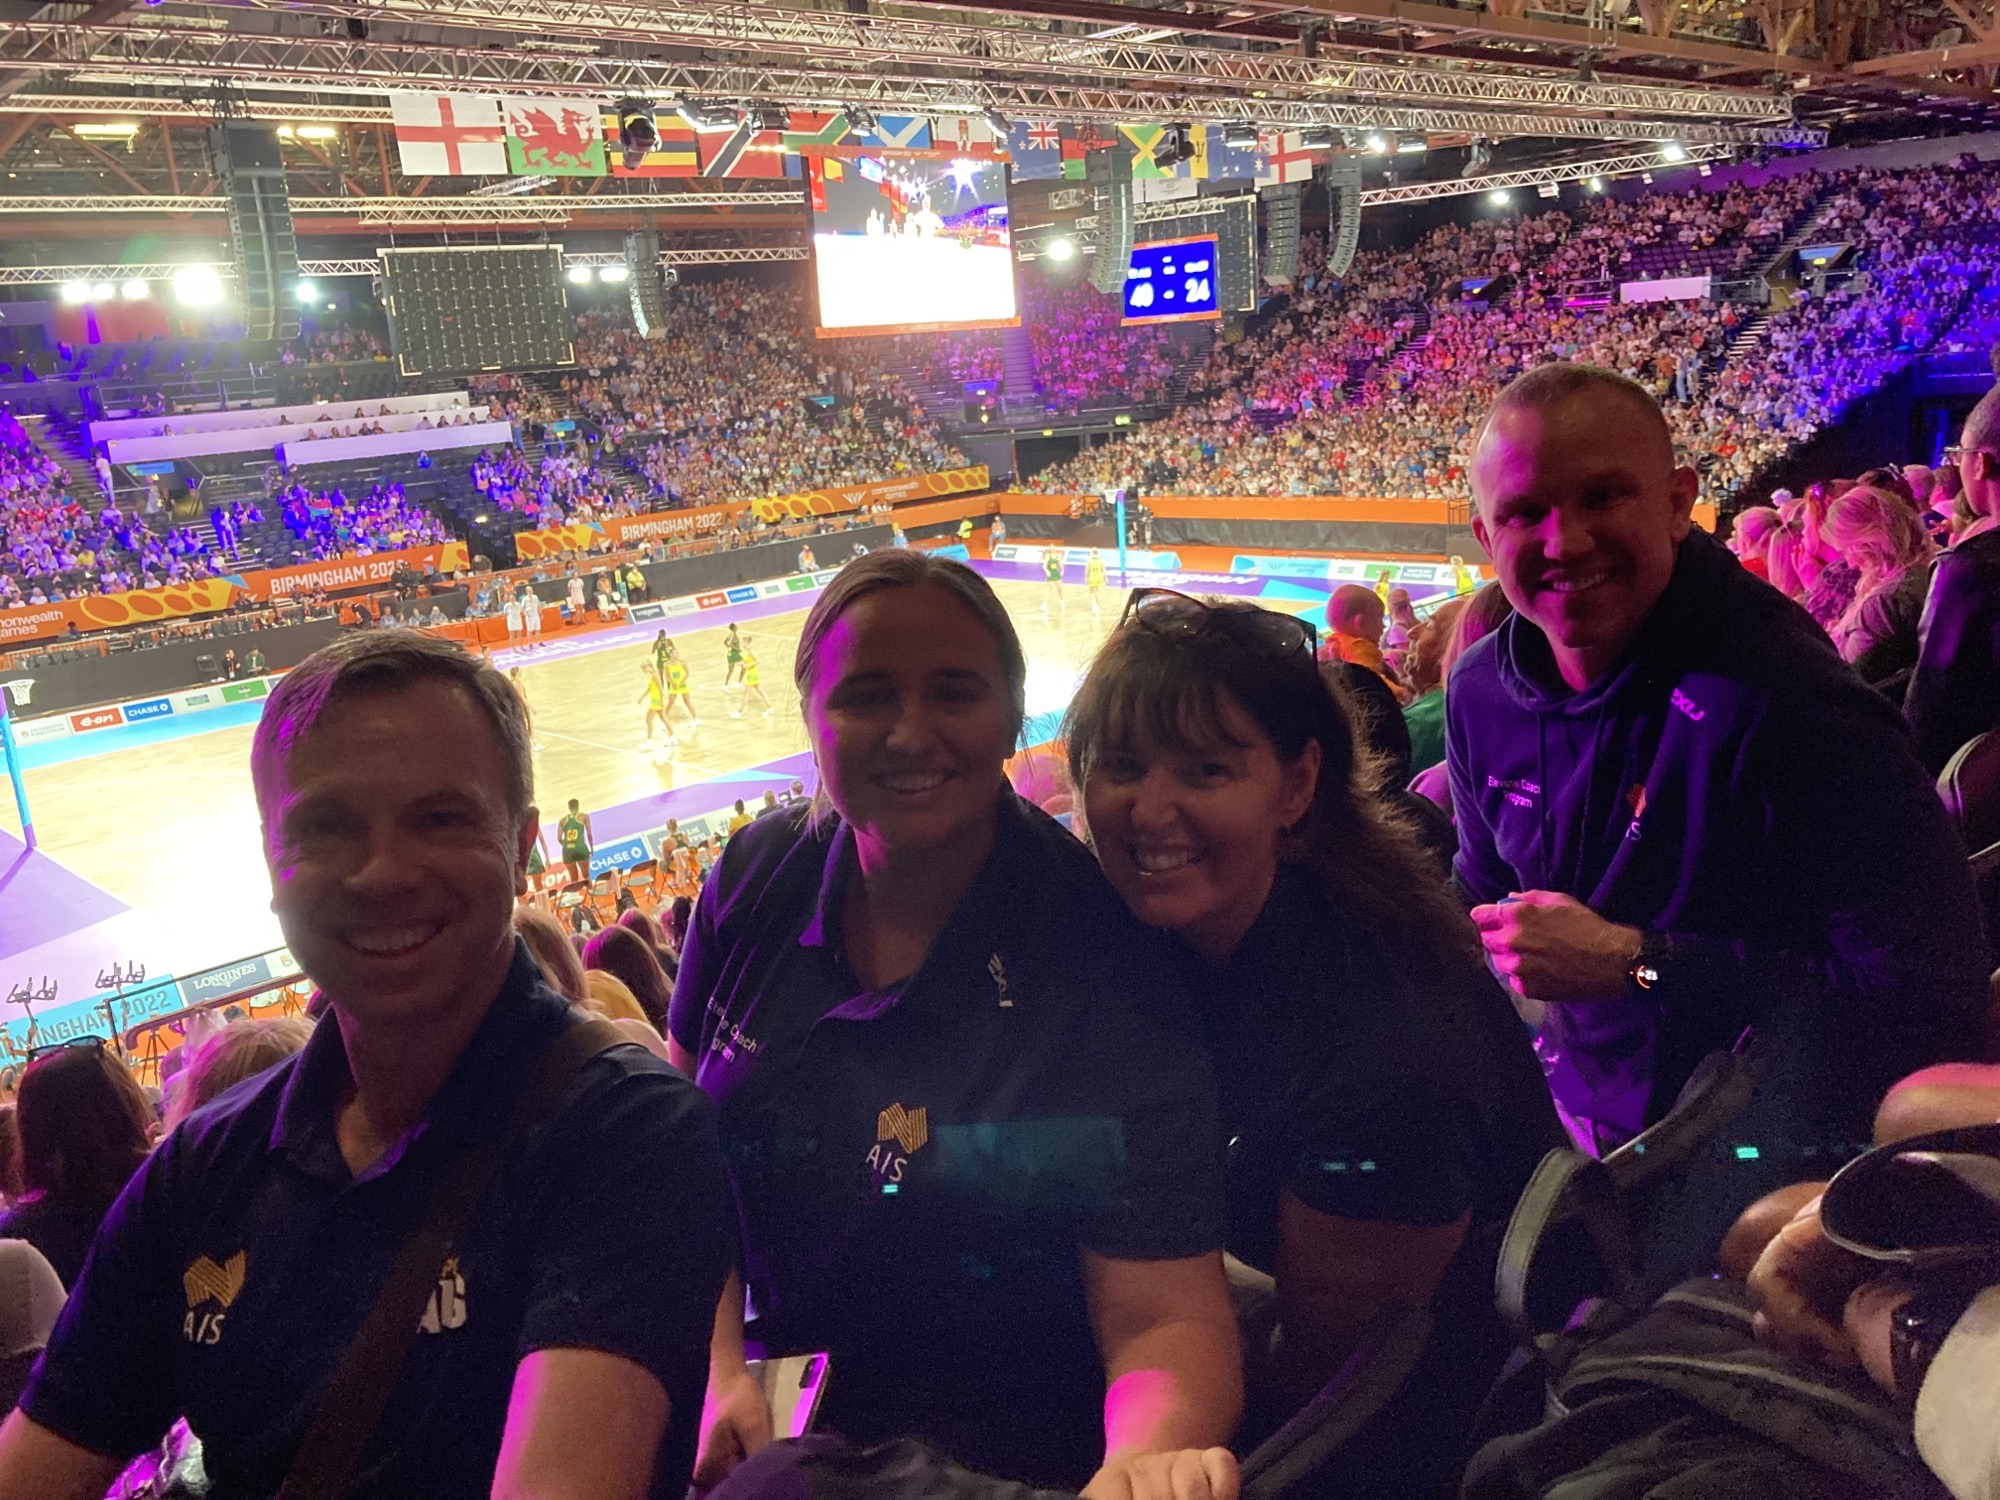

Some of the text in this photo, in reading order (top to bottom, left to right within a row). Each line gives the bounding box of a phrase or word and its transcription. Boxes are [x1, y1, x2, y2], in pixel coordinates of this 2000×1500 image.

[621, 512, 722, 540] BIRMINGHAM 2022
[270, 564, 367, 595] BIRMINGHAM
[128, 705, 160, 717] CHASE
[590, 850, 632, 871] CHASE
[193, 963, 257, 989] LONGINES
[865, 1144, 908, 1183] AIS
[183, 1311, 226, 1345] AIS
